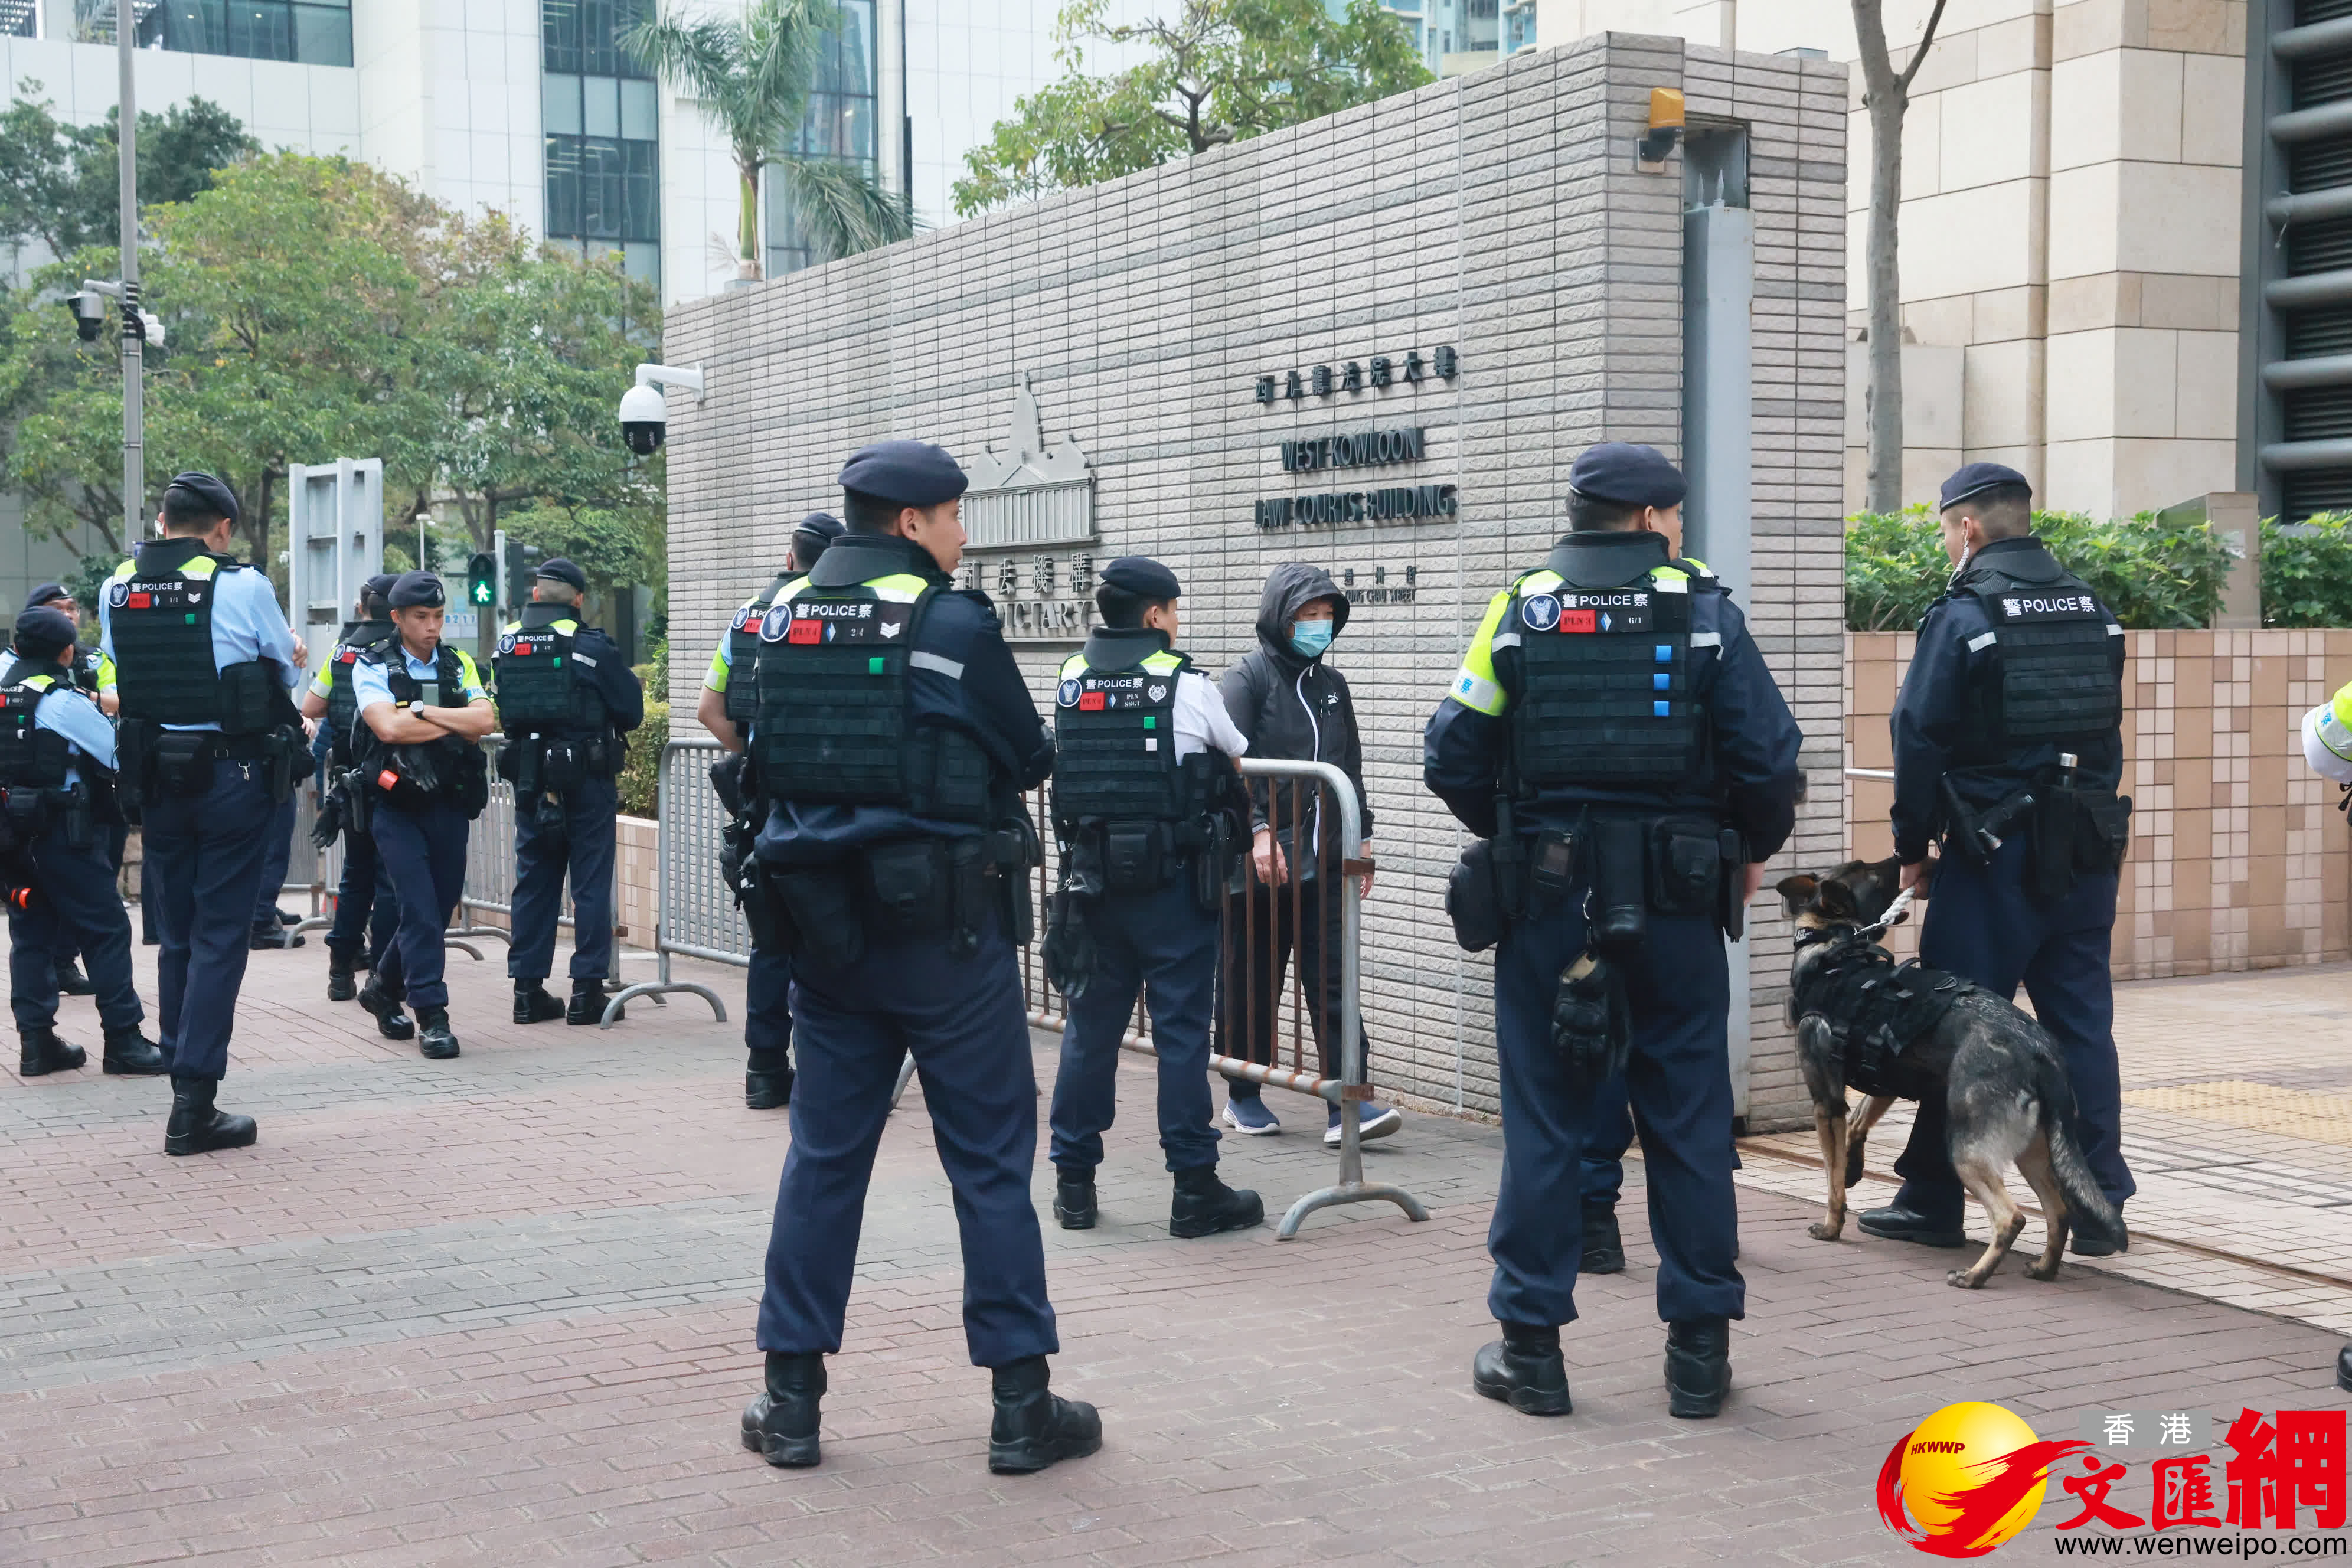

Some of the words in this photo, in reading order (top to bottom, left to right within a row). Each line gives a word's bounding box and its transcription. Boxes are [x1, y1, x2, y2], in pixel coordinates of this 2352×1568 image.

[1281, 437, 1329, 471] WEST
[1331, 427, 1423, 466] KOWLOON
[1255, 498, 1291, 527] LAW
[1294, 492, 1364, 525] COURTS
[1366, 484, 1456, 520] BUILDING
[1346, 589, 1364, 602] UNG
[1367, 589, 1387, 602] CHAU
[1390, 589, 1416, 602] STREET
[1562, 594, 1577, 607] 警
[1580, 594, 1631, 606] POLICE
[1634, 593, 1648, 606] 察
[795, 603, 810, 618] 警
[811, 605, 857, 616] POLICE
[858, 604, 873, 618] 察
[997, 600, 1092, 629] ICIARY
[2003, 598, 2022, 616] 警
[2023, 597, 2079, 613] POLICE
[2078, 596, 2095, 612] 察
[1086, 679, 1096, 690] 警
[1097, 680, 1132, 688] POLICE
[1133, 678, 1144, 688] 察
